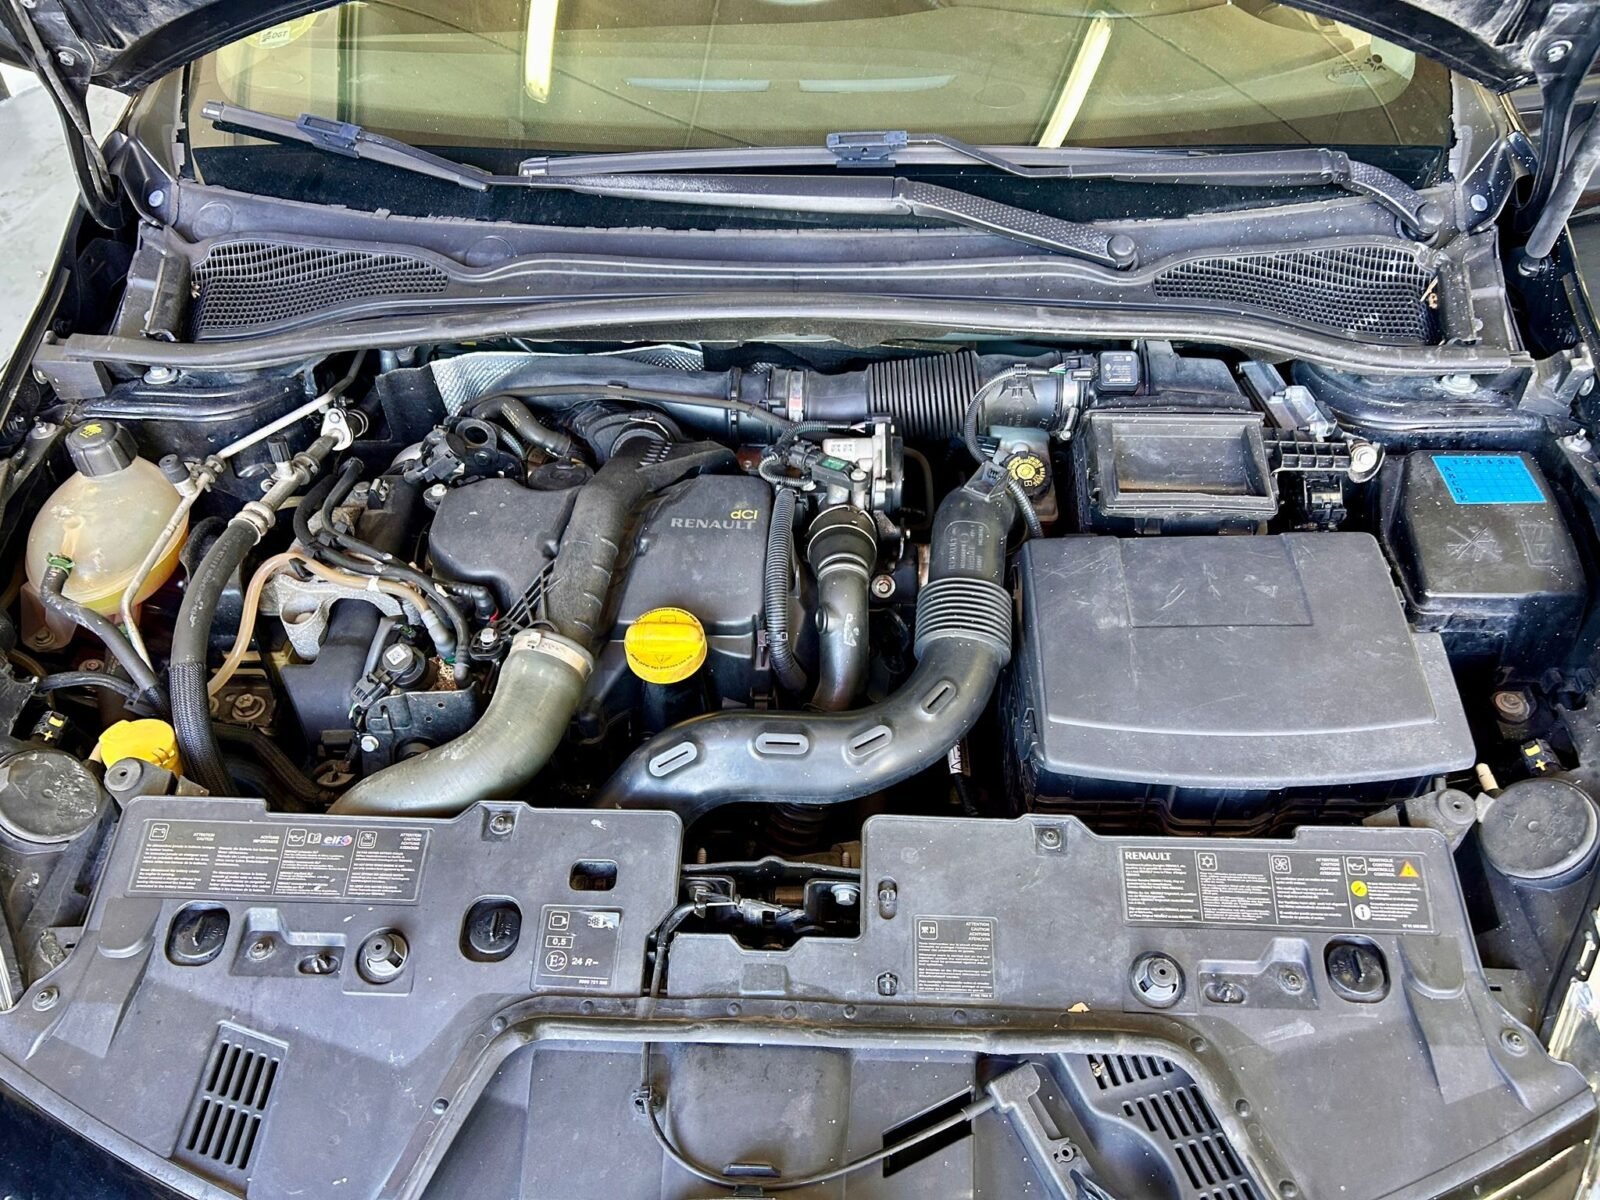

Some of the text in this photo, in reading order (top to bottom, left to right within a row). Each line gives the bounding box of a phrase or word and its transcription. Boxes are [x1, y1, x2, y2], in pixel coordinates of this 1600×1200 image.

[670, 517, 757, 530] RENAULT
[1125, 851, 1172, 861] RENAULT
[552, 937, 567, 946] 0,5
[549, 955, 565, 967] E2
[572, 957, 583, 965] 24
